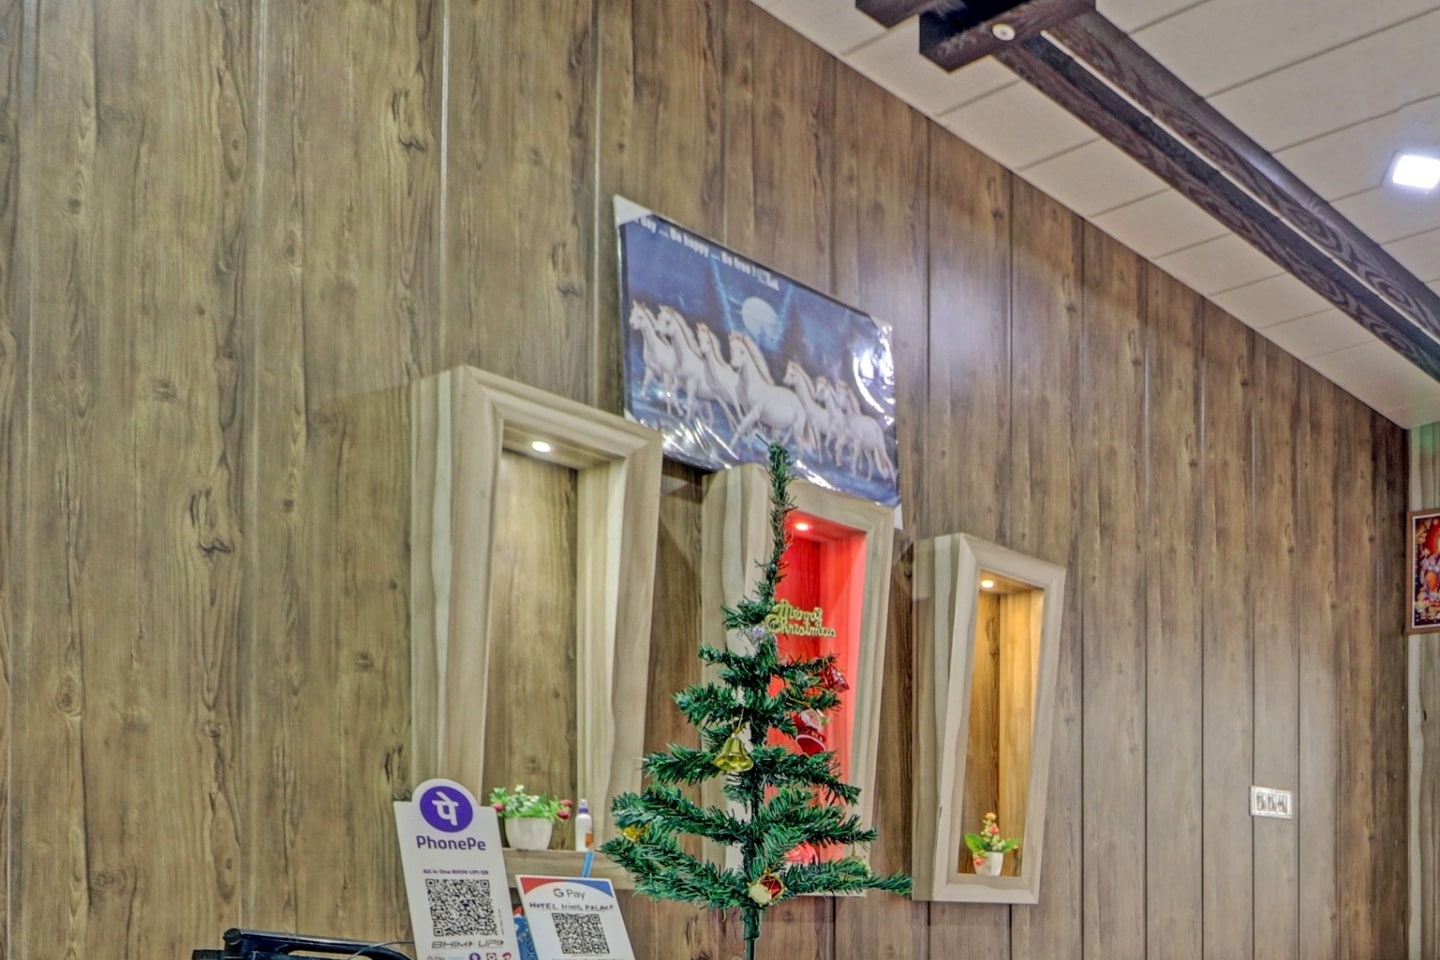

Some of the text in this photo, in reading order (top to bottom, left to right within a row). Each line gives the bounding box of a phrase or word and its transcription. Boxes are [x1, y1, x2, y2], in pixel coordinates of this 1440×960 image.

[772, 599, 823, 623] Merry
[764, 613, 836, 638] Christmas
[416, 835, 487, 851] PhonePe
[553, 888, 586, 900] G Pay
[432, 940, 500, 949] BHIM UPI
